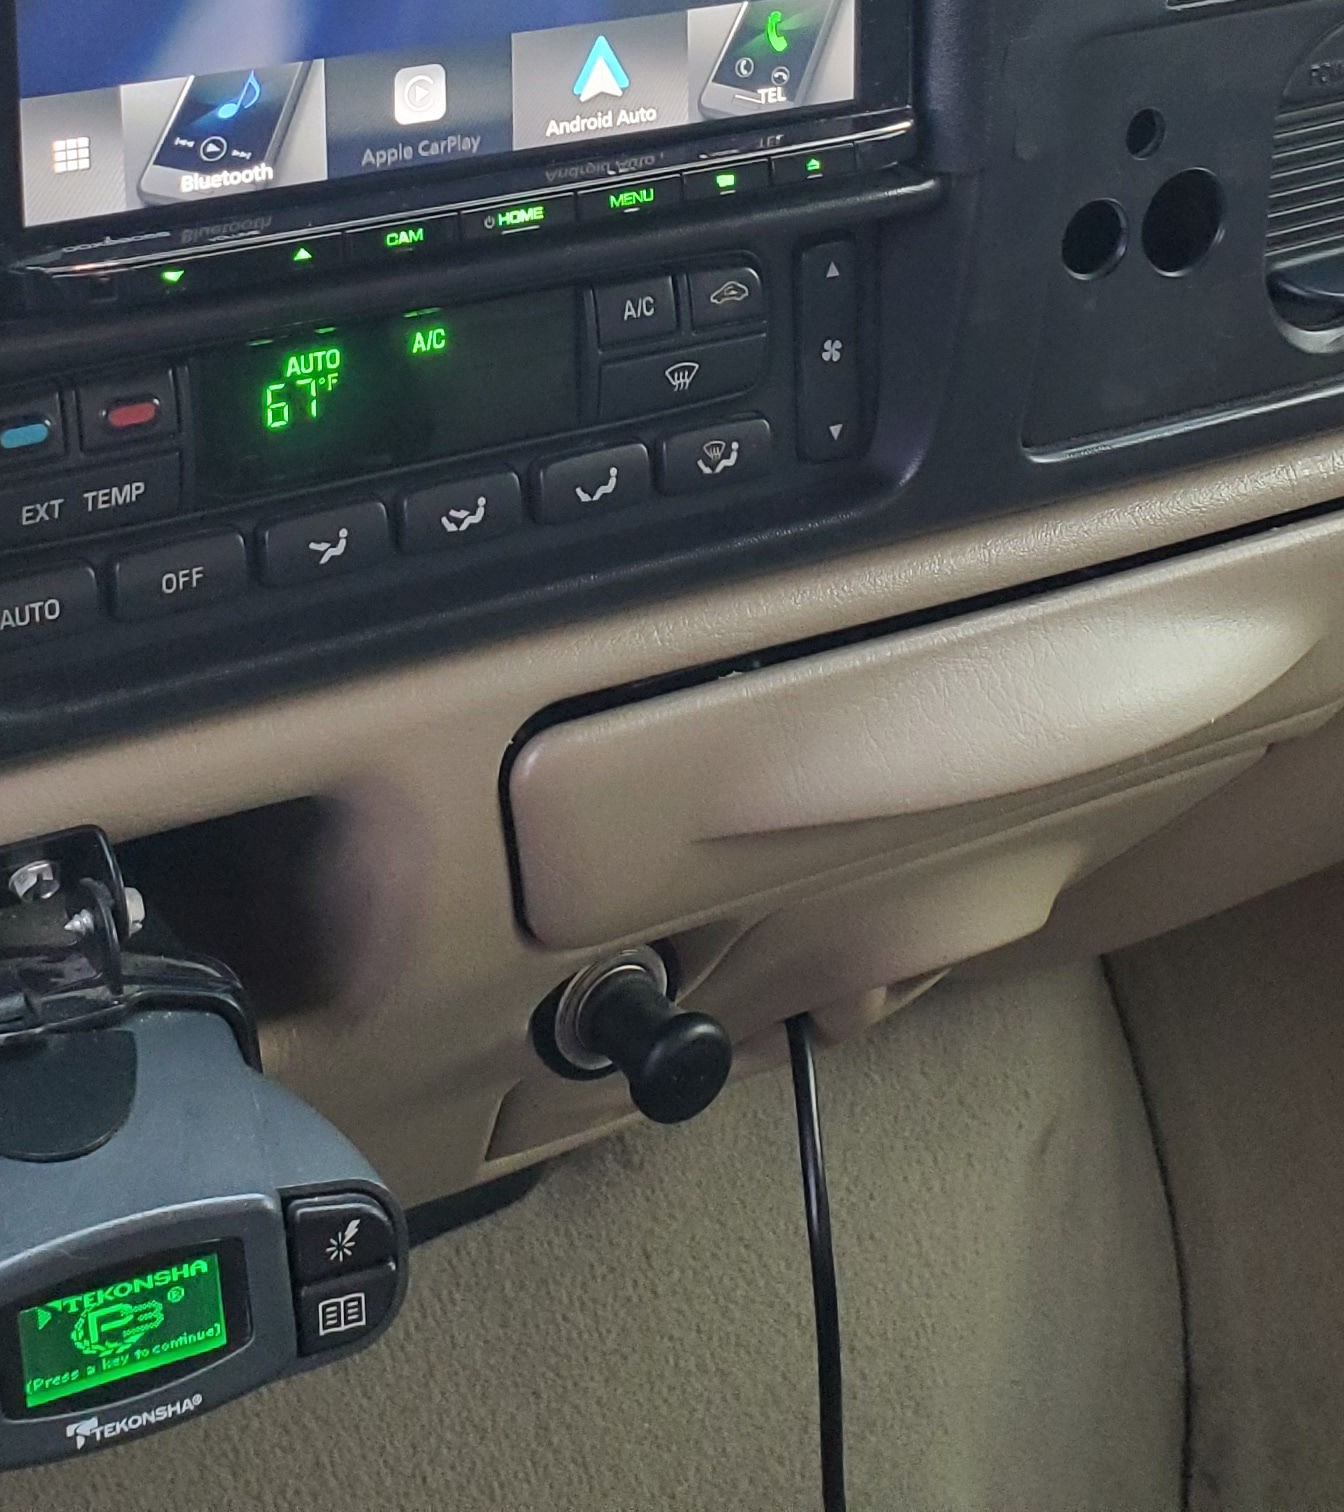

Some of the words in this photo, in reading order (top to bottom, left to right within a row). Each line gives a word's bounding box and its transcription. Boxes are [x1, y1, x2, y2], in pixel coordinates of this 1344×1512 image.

[757, 87, 787, 104] TEL
[546, 112, 613, 137] Android
[616, 105, 657, 126] Auto
[362, 140, 413, 167] Apple
[419, 133, 482, 160] CarPlay
[180, 162, 274, 194] Bluetooth
[609, 188, 655, 209] MENU
[498, 206, 545, 227] HOME
[385, 228, 424, 248] CAM
[623, 296, 655, 321] A/C
[412, 328, 447, 355] A/C
[285, 348, 341, 377] AUTO
[21, 499, 64, 526] EXT
[83, 481, 145, 513] TEMP
[161, 566, 204, 594] OFF
[0, 598, 60, 631] AUTO
[62, 1259, 208, 1313] TEKONSHA
[103, 1354, 130, 1370] key
[135, 1348, 150, 1360] to
